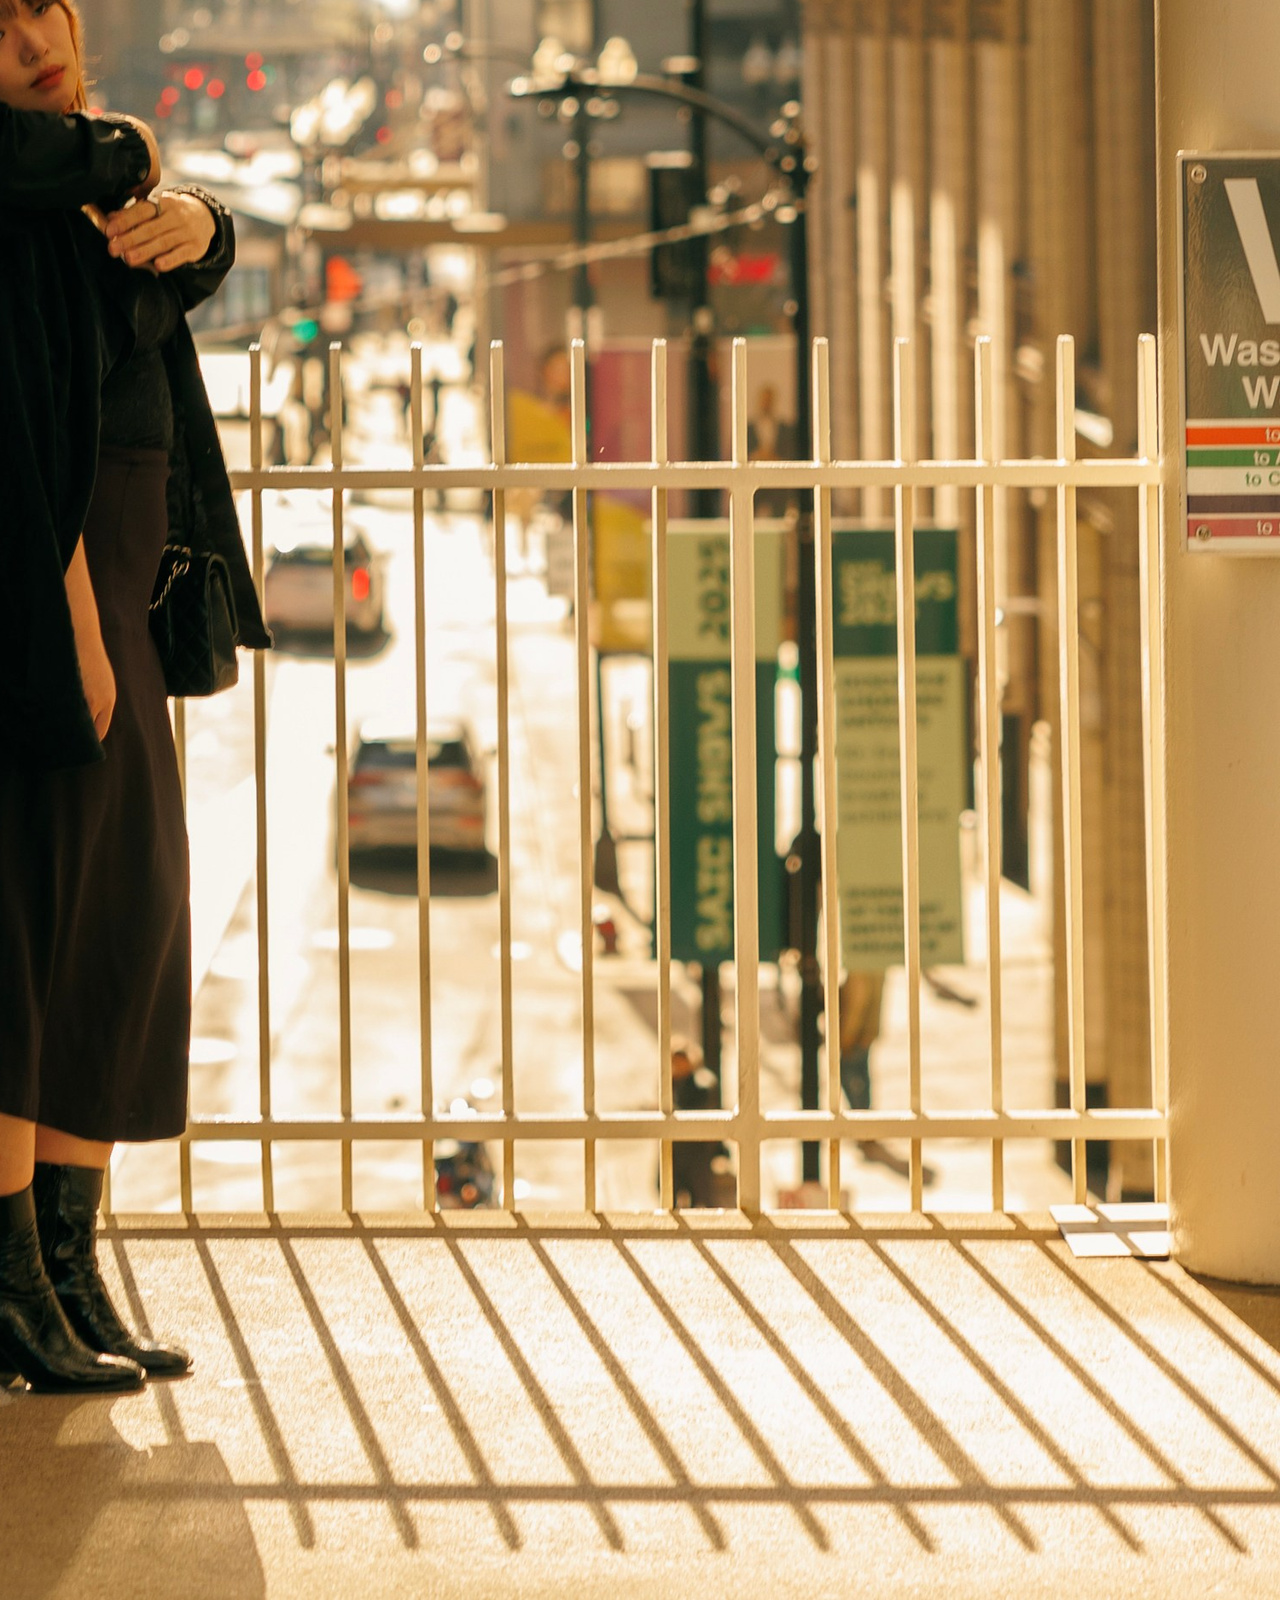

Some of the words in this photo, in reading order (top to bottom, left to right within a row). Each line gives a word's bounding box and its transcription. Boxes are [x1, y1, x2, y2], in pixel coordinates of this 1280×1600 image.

[1265, 426, 1280, 442] to
[1253, 450, 1270, 466] to
[1245, 471, 1262, 487] to
[1257, 520, 1273, 535] to
